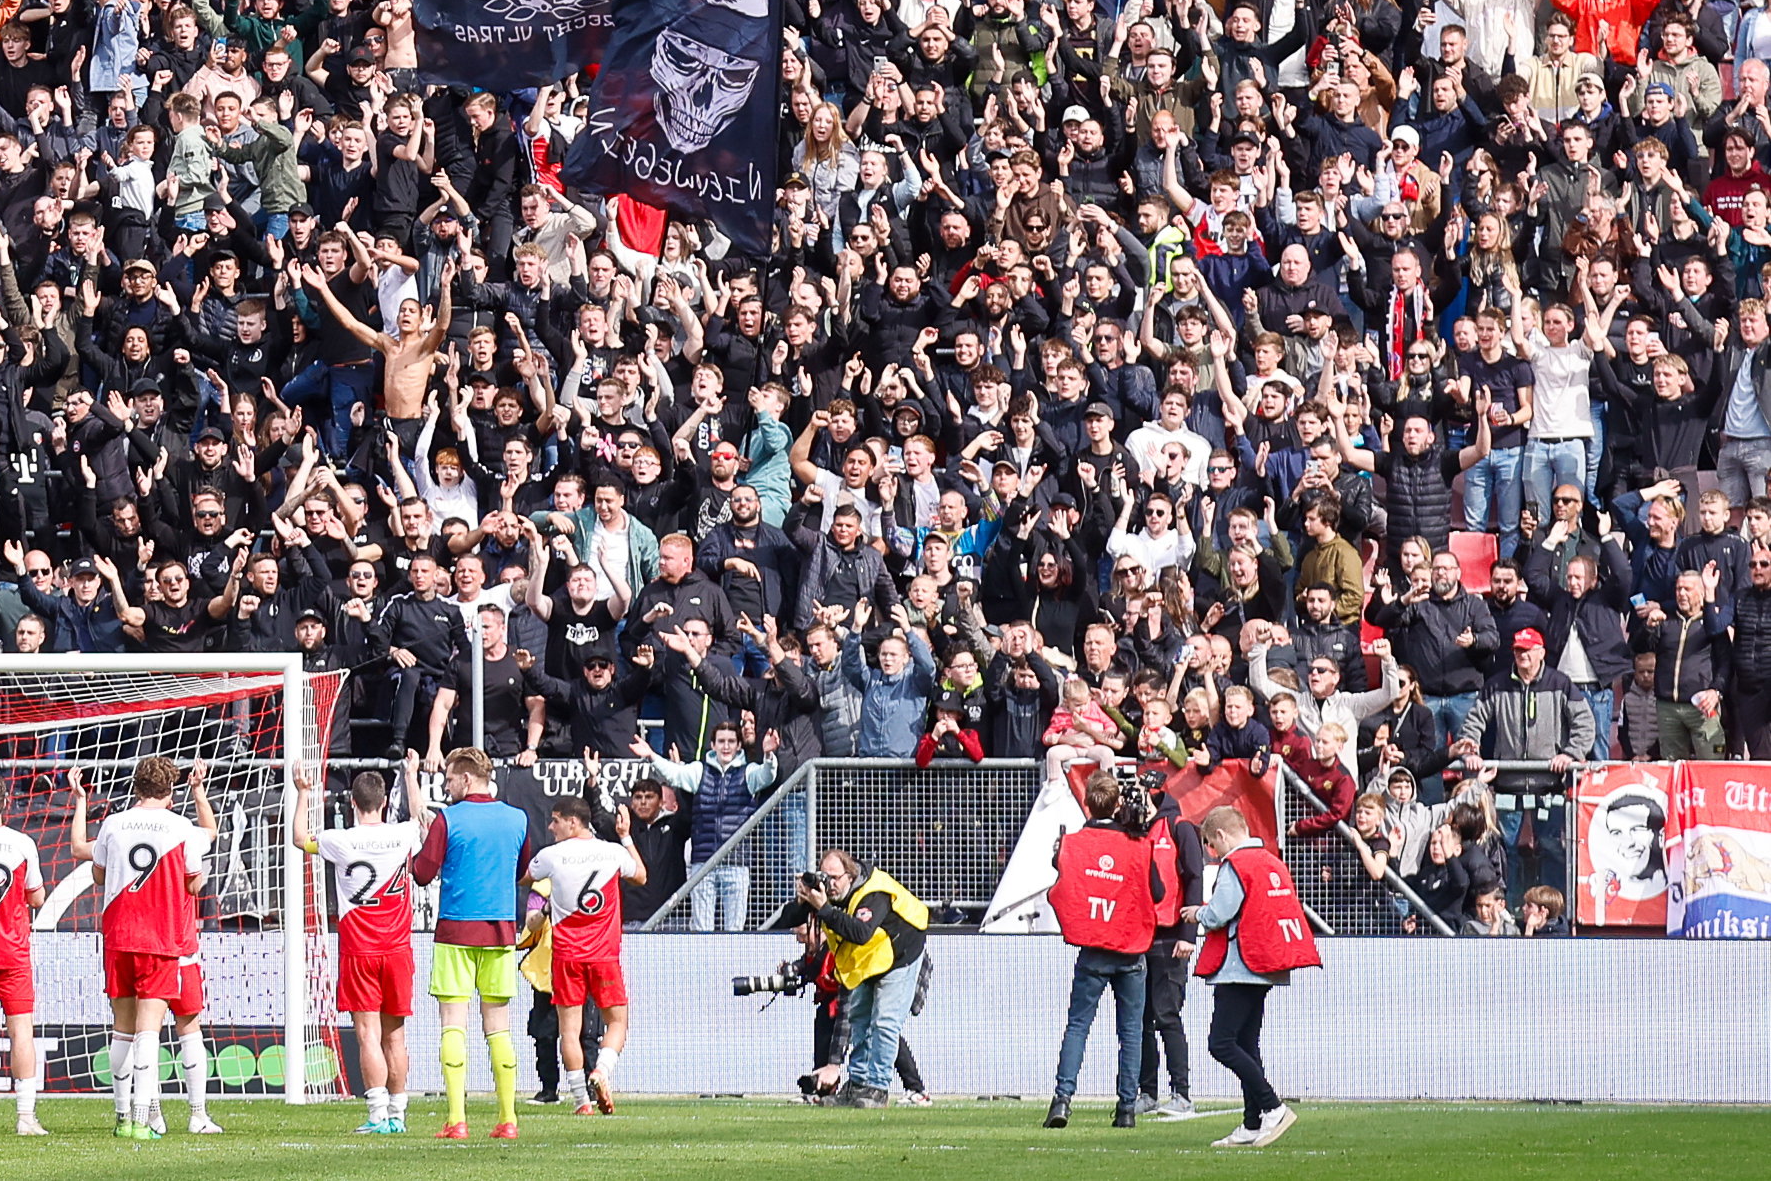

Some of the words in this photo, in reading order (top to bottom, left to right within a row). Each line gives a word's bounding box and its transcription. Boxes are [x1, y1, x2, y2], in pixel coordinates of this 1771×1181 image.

[532, 761, 656, 781] UTRCHT
[1724, 780, 1771, 813] Ut
[120, 820, 171, 834] LAMMERS
[127, 842, 158, 893] 9
[344, 858, 408, 907] 24
[576, 869, 605, 917] 6
[1087, 896, 1117, 923] TV
[1277, 917, 1305, 943] TV
